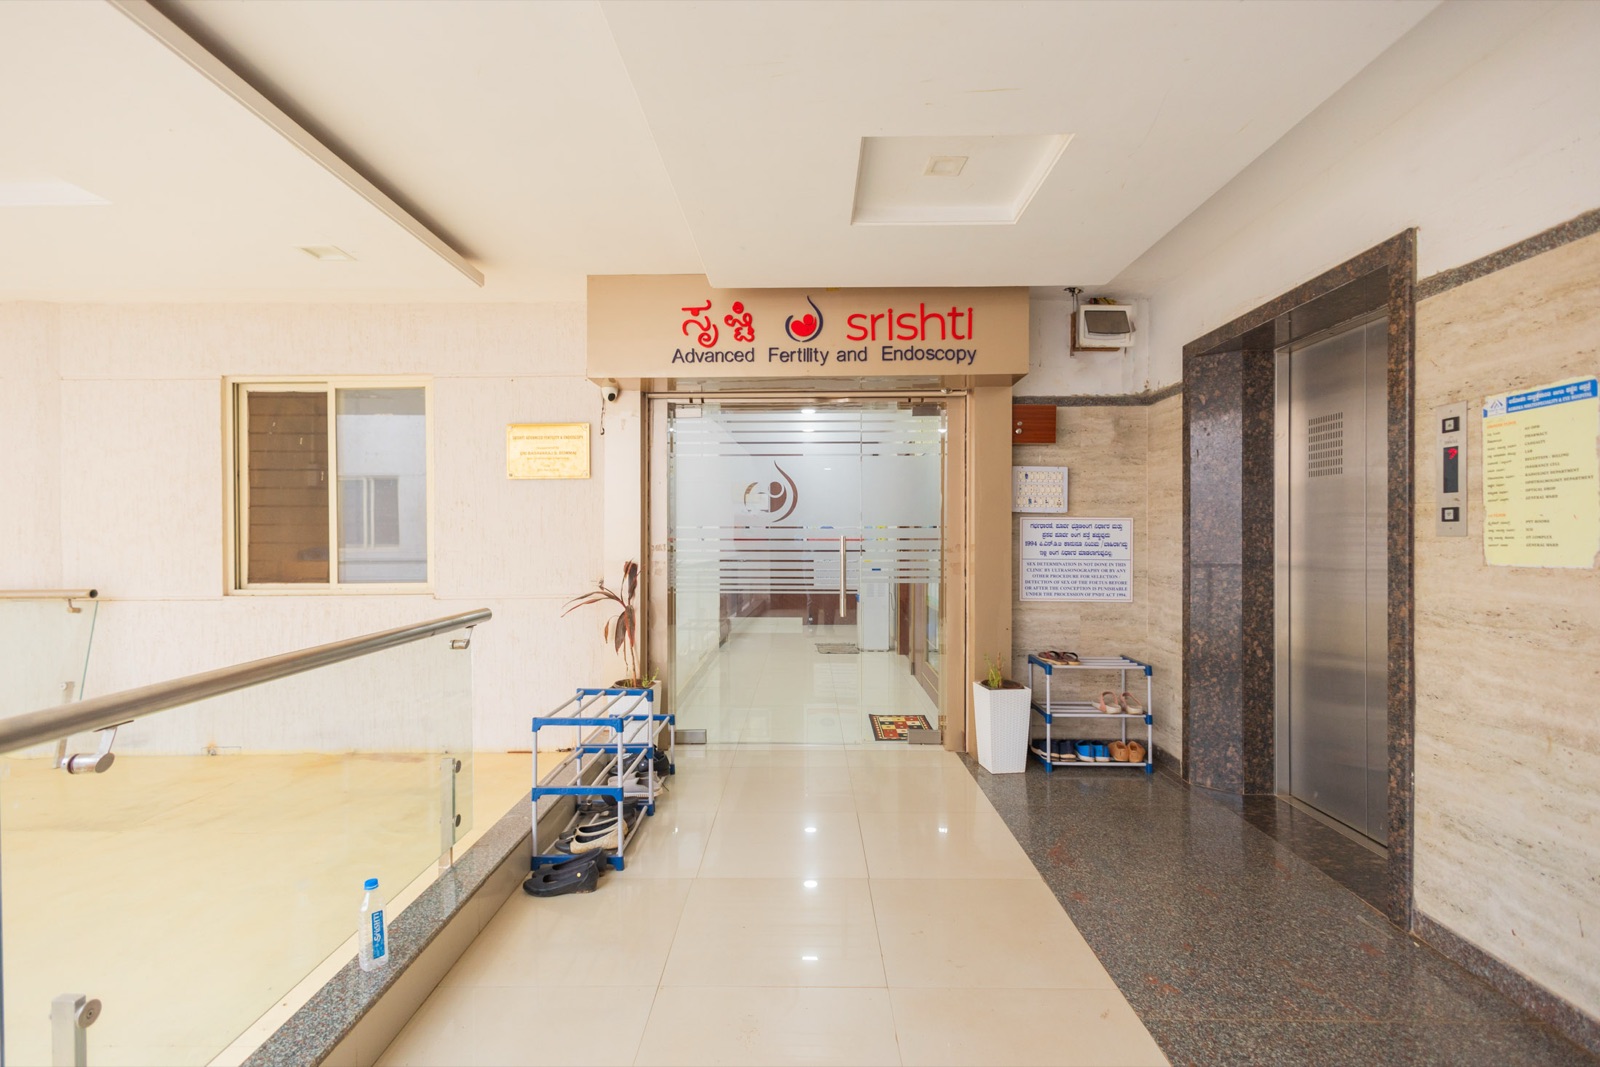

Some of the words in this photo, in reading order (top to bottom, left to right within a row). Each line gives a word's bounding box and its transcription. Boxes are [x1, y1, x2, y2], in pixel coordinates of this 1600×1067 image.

[682, 300, 755, 348] ಸೃಷ್ಟಿ
[846, 303, 974, 342] srishti
[672, 347, 755, 364] Advanced
[769, 346, 829, 366] Fertility
[837, 347, 867, 362] and
[882, 346, 976, 365] Endoscopy
